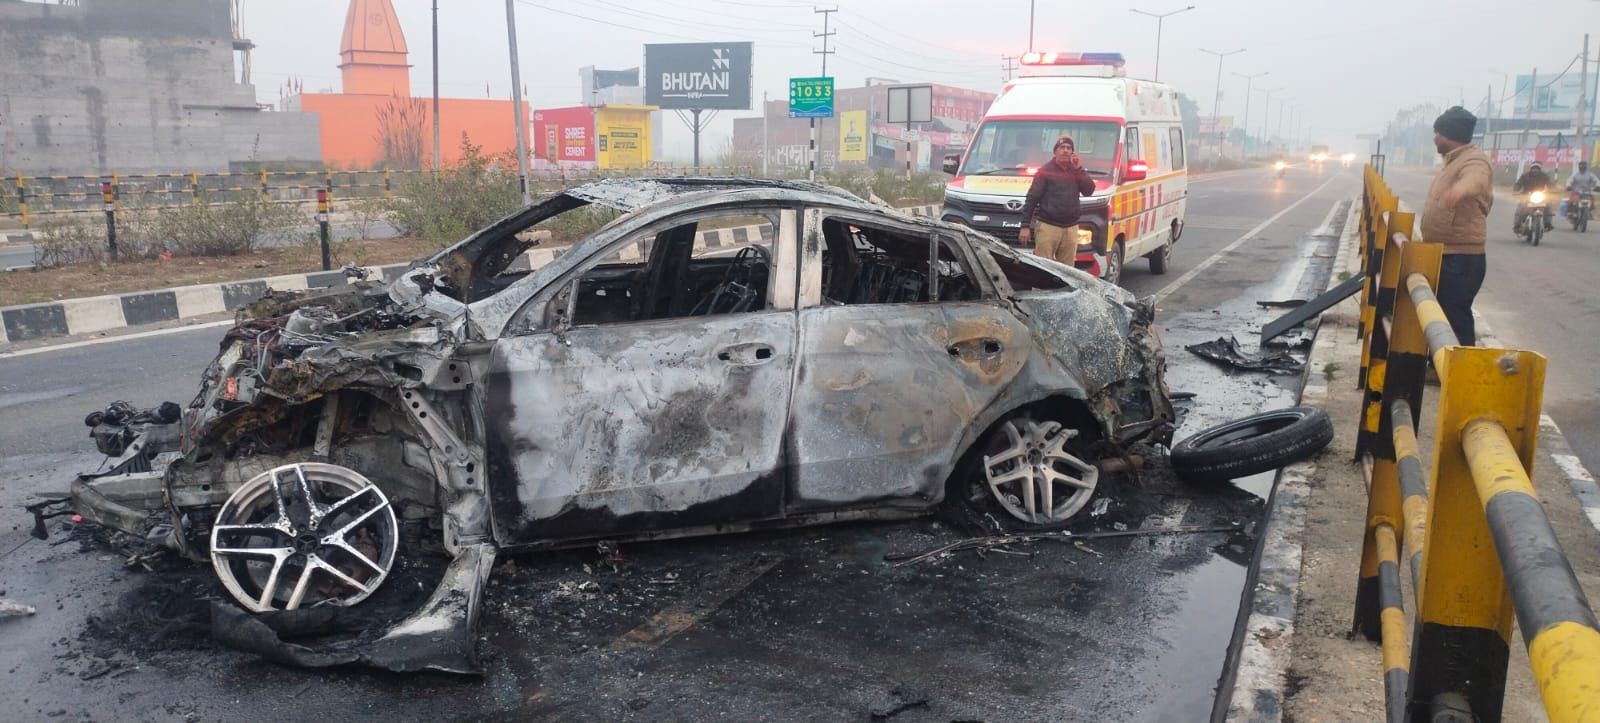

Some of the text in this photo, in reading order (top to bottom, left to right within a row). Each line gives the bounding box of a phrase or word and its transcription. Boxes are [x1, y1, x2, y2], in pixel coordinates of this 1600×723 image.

[662, 72, 729, 90] BHUTANI
[797, 86, 831, 97] 1033
[564, 127, 586, 139] SHREE
[565, 146, 586, 157] CEMENT
